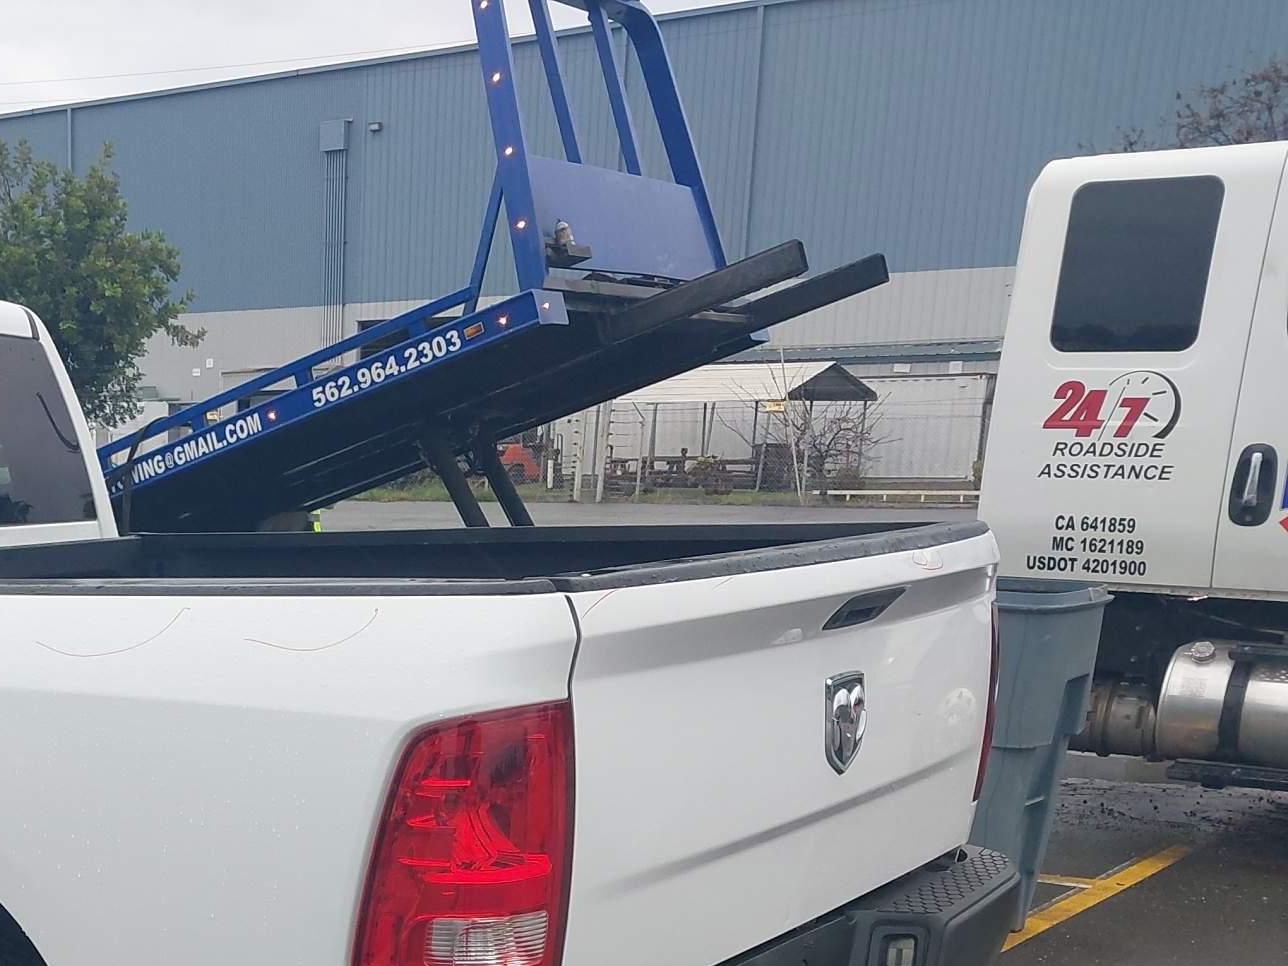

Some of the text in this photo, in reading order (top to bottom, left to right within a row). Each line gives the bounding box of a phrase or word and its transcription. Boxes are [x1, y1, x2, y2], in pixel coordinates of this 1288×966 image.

[310, 330, 462, 409] 562.964.2303
[1052, 441, 1166, 458] ROADSIDE
[1037, 463, 1175, 481] ASSISTANCE
[1054, 515, 1137, 534] CA 641859
[1051, 536, 1145, 556] MC 1621189
[1026, 555, 1147, 577] USDOT 4201900
